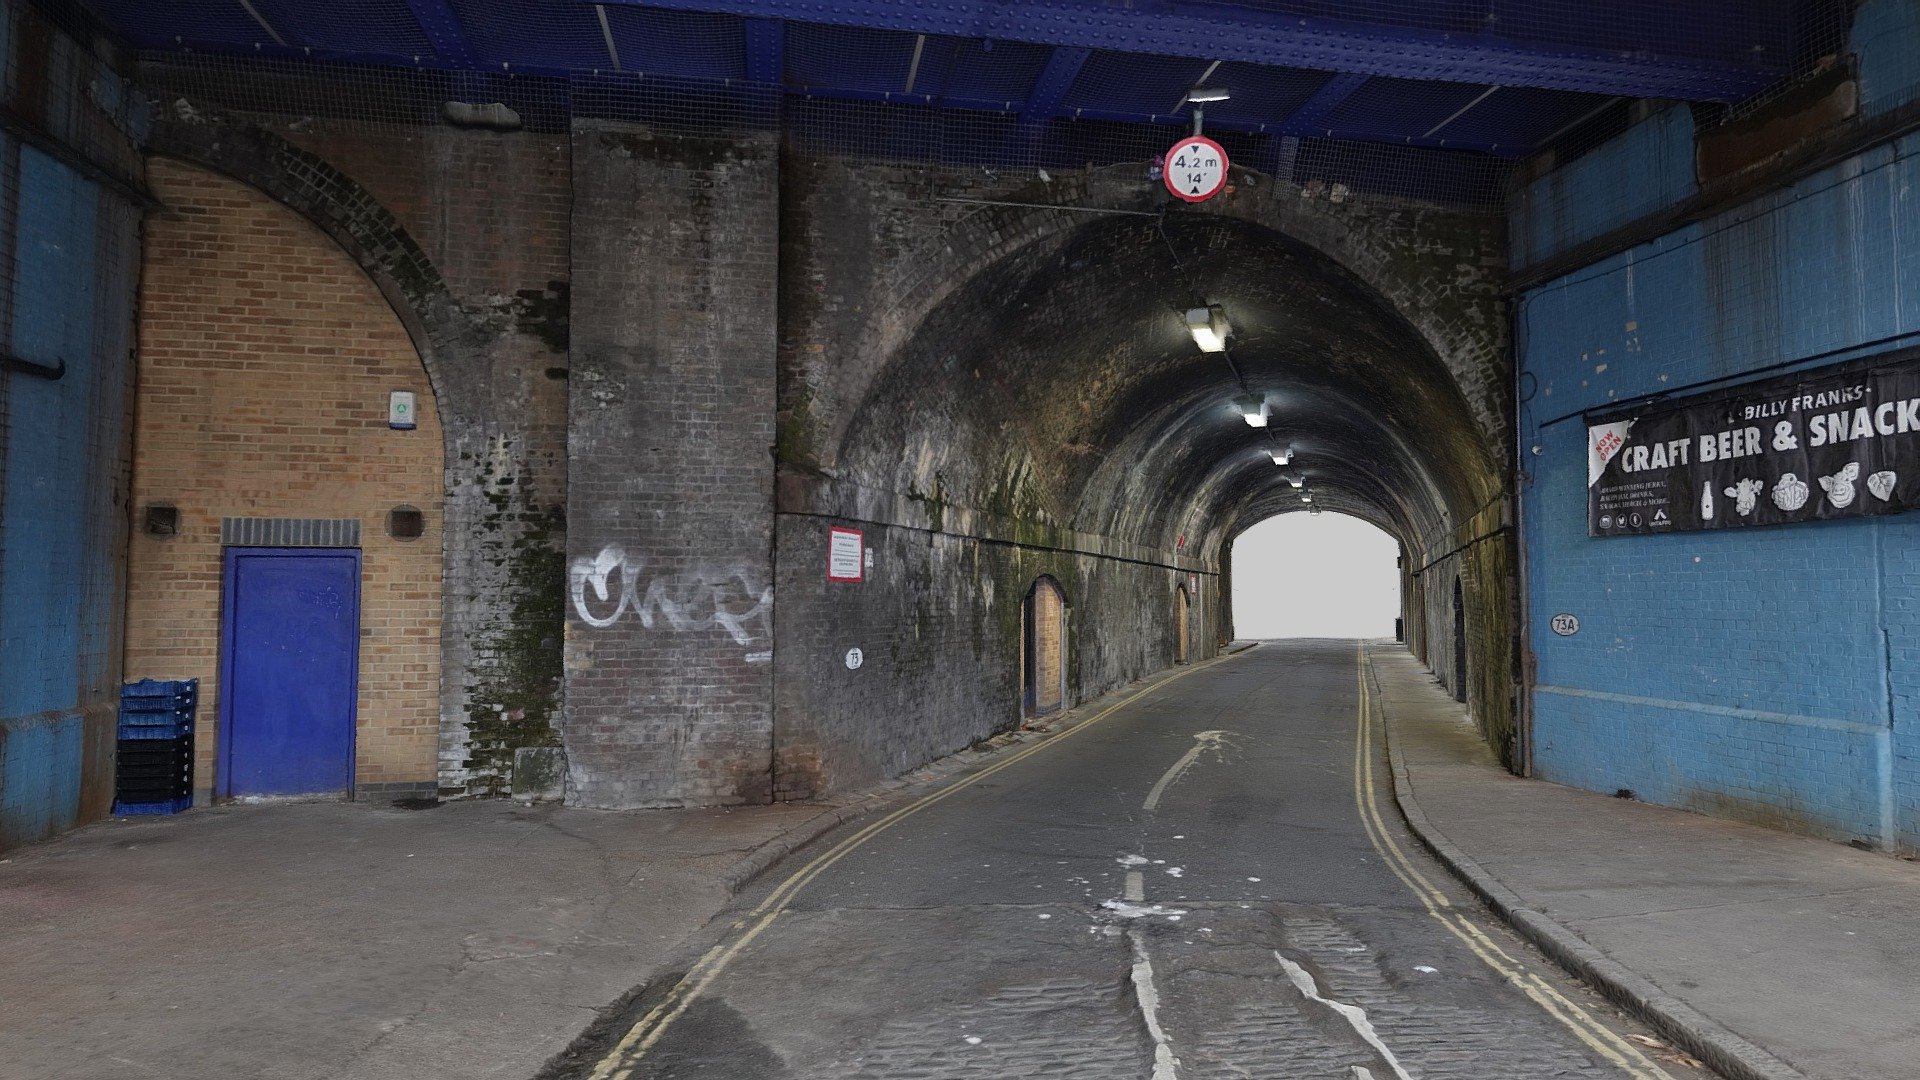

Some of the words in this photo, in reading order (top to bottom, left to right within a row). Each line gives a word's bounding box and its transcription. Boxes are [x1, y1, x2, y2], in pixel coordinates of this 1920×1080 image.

[1174, 155, 1201, 168] 4.2
[1204, 158, 1217, 168] m
[1744, 400, 1788, 420] BILLY
[1791, 385, 1863, 412] FRANKS
[1595, 431, 1613, 454] NOW
[1621, 438, 1691, 473] CRAFT
[1699, 426, 1764, 463] BEER
[1772, 420, 1799, 452] &
[1809, 398, 1920, 447] SNACK
[1600, 436, 1621, 461] OPEN
[1555, 618, 1575, 631] 73A
[850, 652, 859, 666] 73
